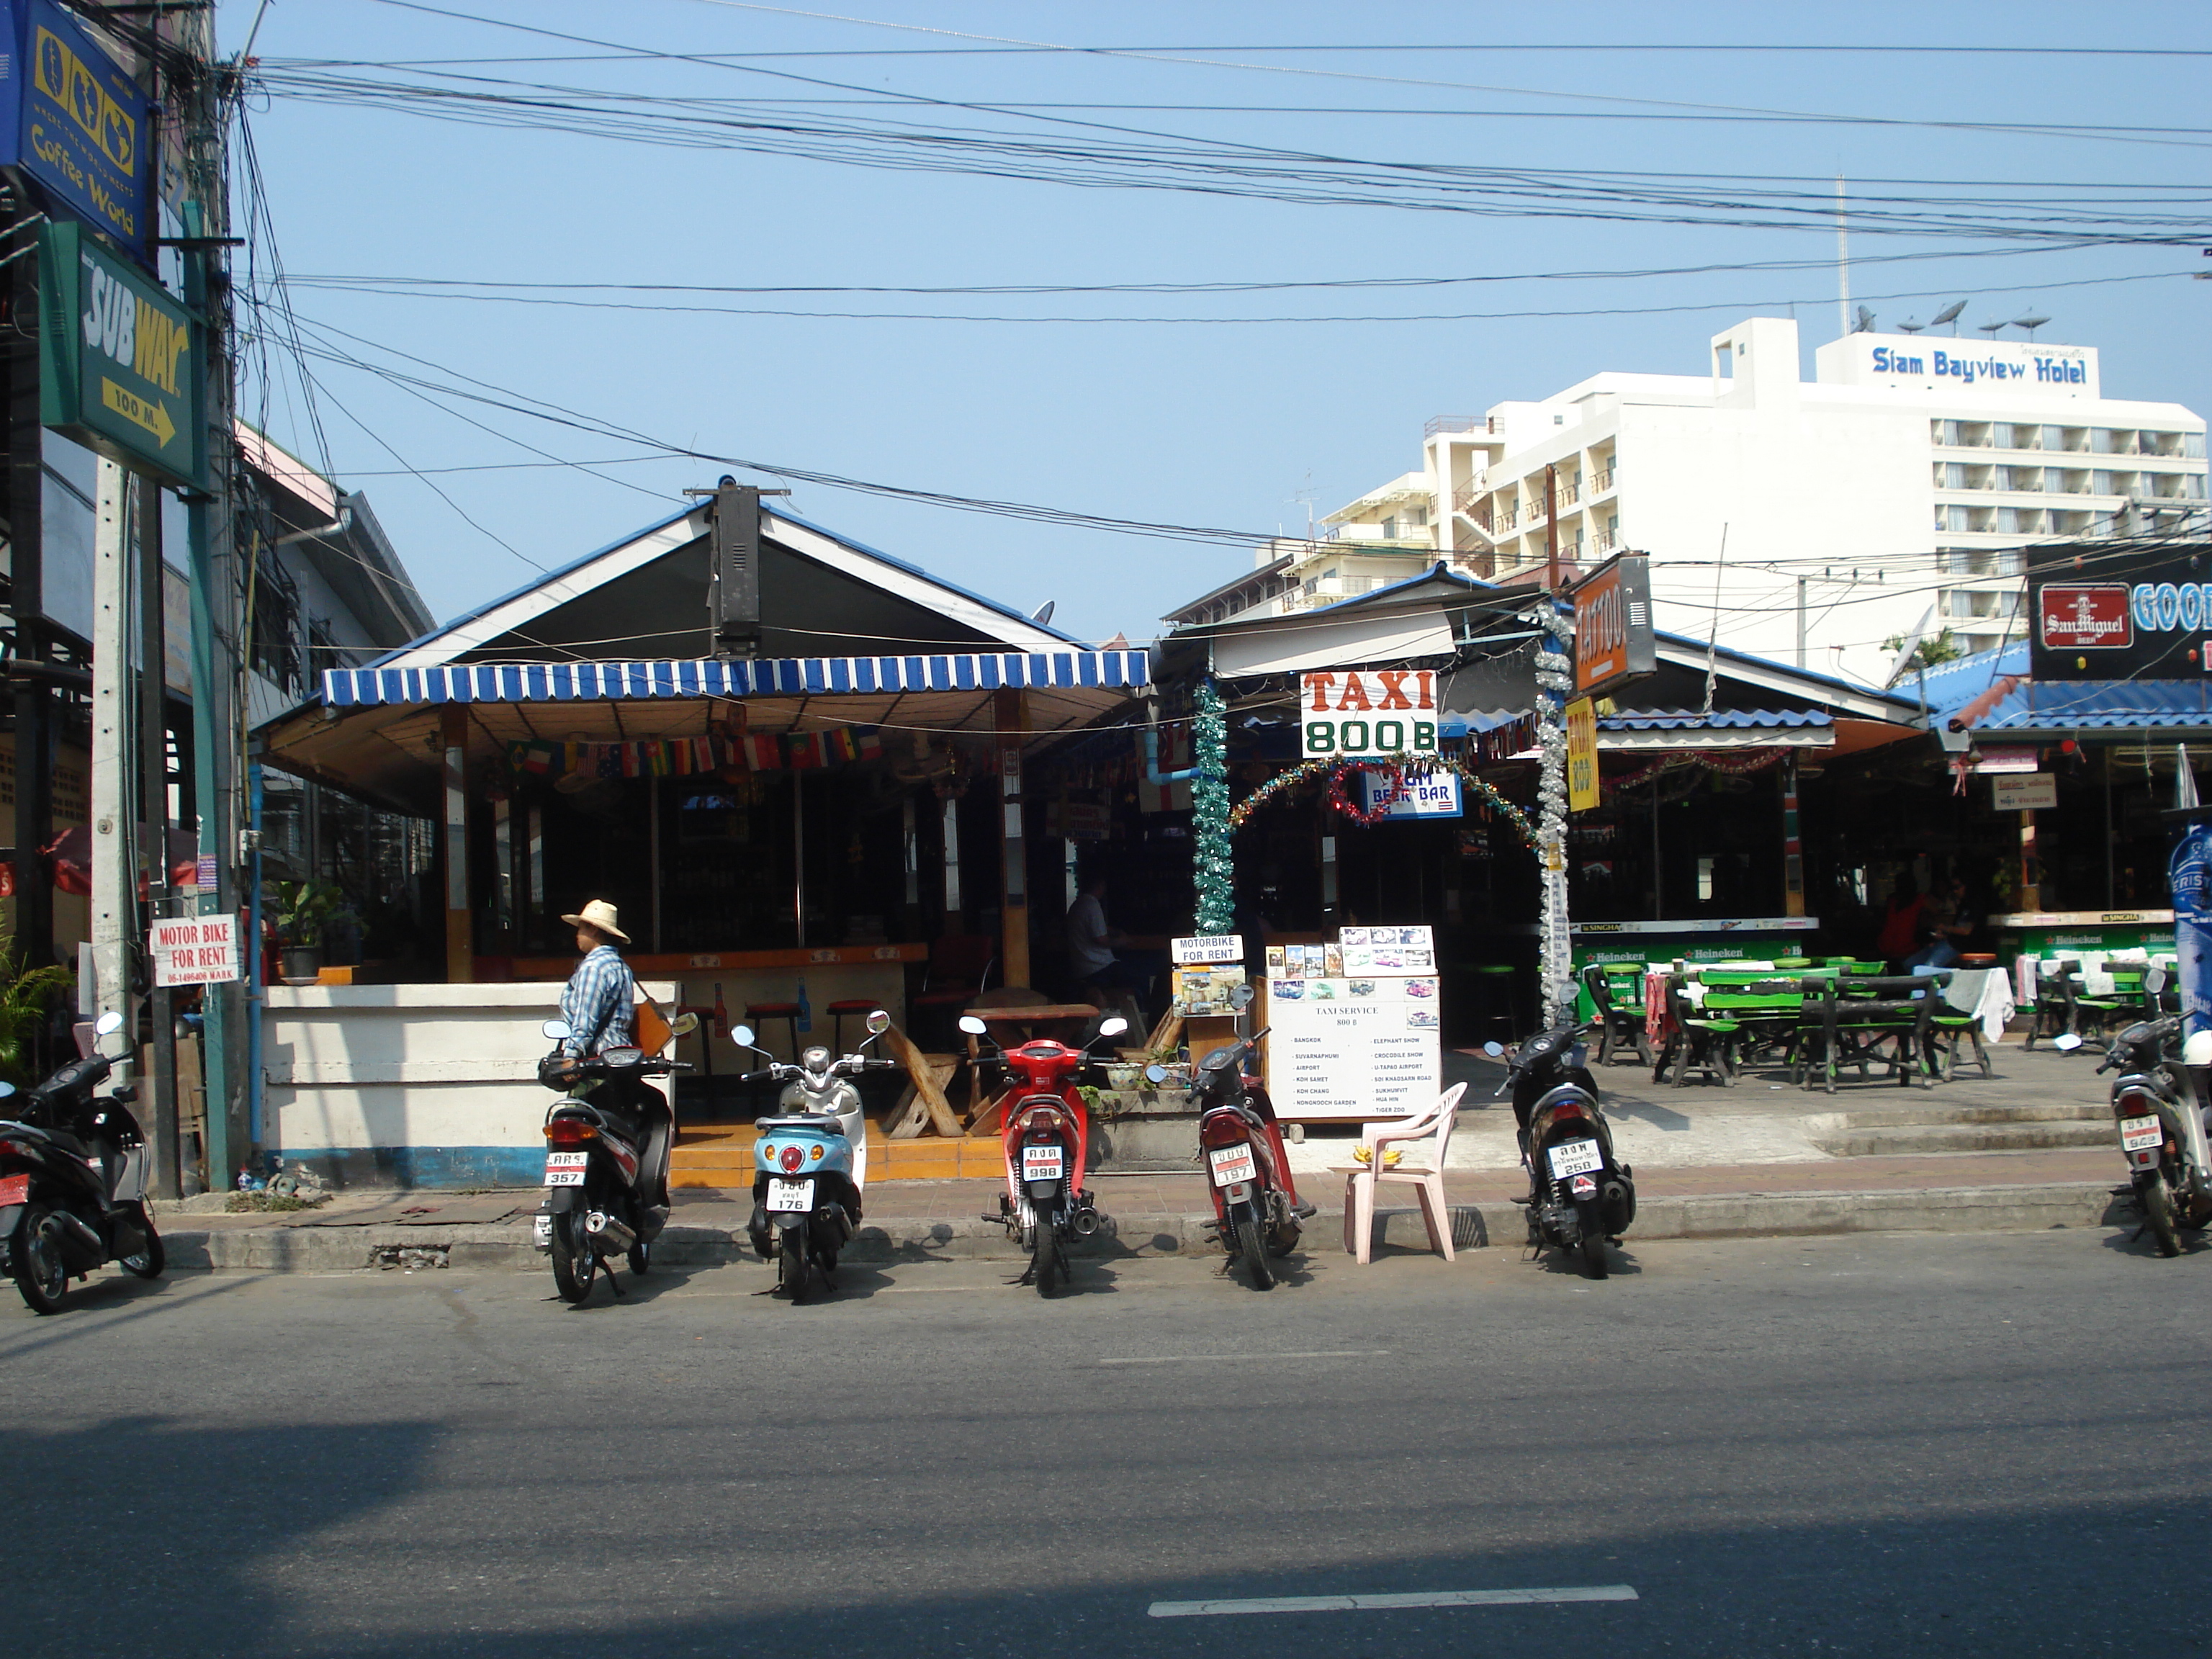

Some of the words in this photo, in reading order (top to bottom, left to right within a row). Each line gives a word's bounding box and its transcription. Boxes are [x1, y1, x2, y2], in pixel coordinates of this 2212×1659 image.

[32, 124, 84, 190] Coffee
[88, 174, 133, 236] World
[83, 266, 189, 395] SUBWAY
[1872, 347, 1924, 374] Siam
[1933, 350, 2026, 383] Bayview
[2034, 356, 2087, 384] Hotel
[116, 389, 139, 417] 100
[144, 405, 158, 429] M.
[2077, 613, 2123, 639] Miguel
[1304, 672, 1434, 711] TAXI
[1419, 786, 1449, 801] BAR
[159, 926, 198, 945] MOTOR
[202, 923, 228, 943] BIKE
[2056, 935, 2103, 945] Heineken
[1180, 937, 1235, 948] MOTORBIKE
[172, 949, 194, 968] FOR
[199, 947, 226, 966] RENT
[1183, 951, 1203, 961] FOR
[1208, 949, 1233, 959] RENT
[1596, 951, 1645, 962] Heineken
[1695, 948, 1743, 959] Heineken
[209, 970, 233, 980] MARK
[1339, 1007, 1378, 1015] SERVICE
[550, 1174, 578, 1183] 357
[1030, 1167, 1056, 1177] 998
[1223, 1166, 1247, 1181] 197
[778, 1200, 804, 1209] 176
